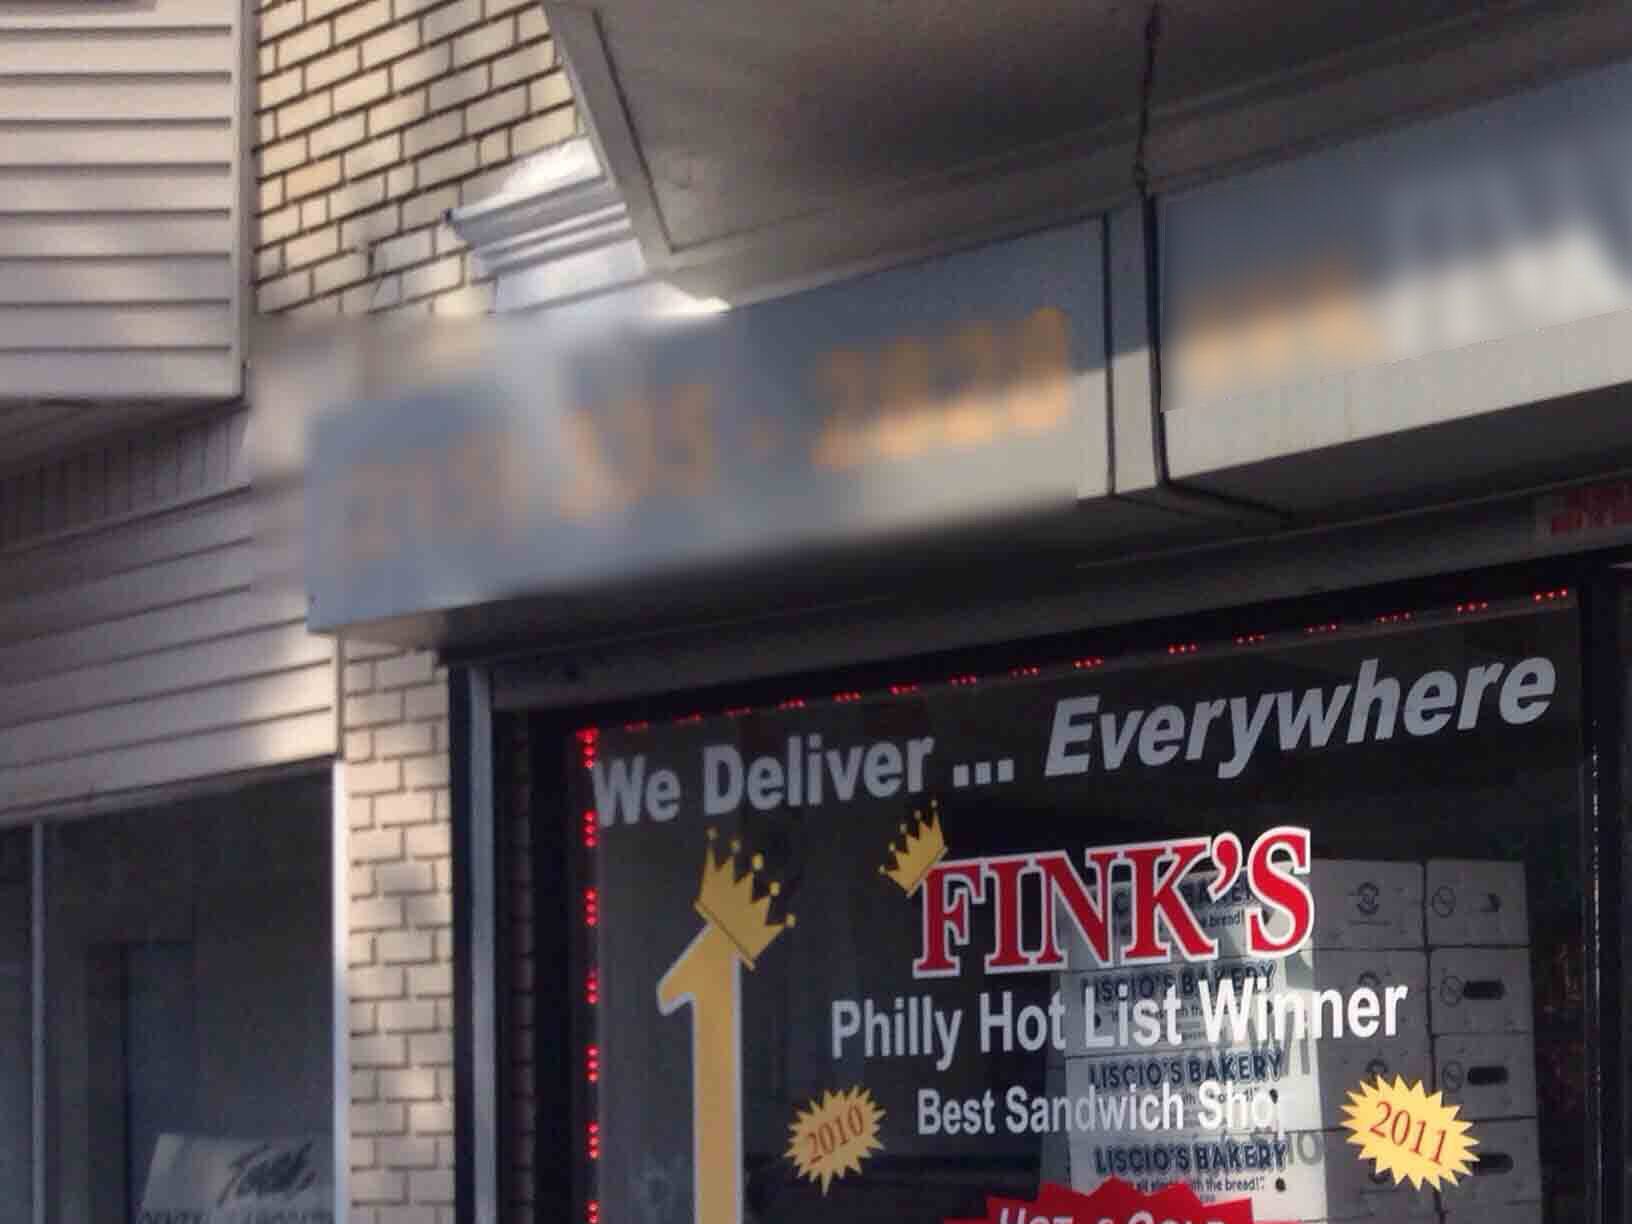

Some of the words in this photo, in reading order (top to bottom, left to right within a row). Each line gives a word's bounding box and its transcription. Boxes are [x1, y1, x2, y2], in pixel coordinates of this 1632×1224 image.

[593, 754, 680, 827] We
[703, 733, 935, 816] Deliver
[1044, 656, 1557, 779] Everywhere
[913, 826, 1315, 980] FINK'S
[831, 995, 963, 1071] Philly
[979, 989, 1068, 1055] Hot
[1084, 983, 1183, 1049] List
[1198, 976, 1409, 1044] Winner
[1090, 1061, 1182, 1090] LISCIO'S
[1189, 1051, 1283, 1084] BAKERY
[804, 1102, 866, 1166] 2010
[917, 1088, 996, 1136] Best
[1005, 1083, 1185, 1135] Sandwich
[1370, 1101, 1447, 1166] 2011
[1096, 1147, 1190, 1174] LISCIO'S
[1191, 1143, 1287, 1171] BAKERY
